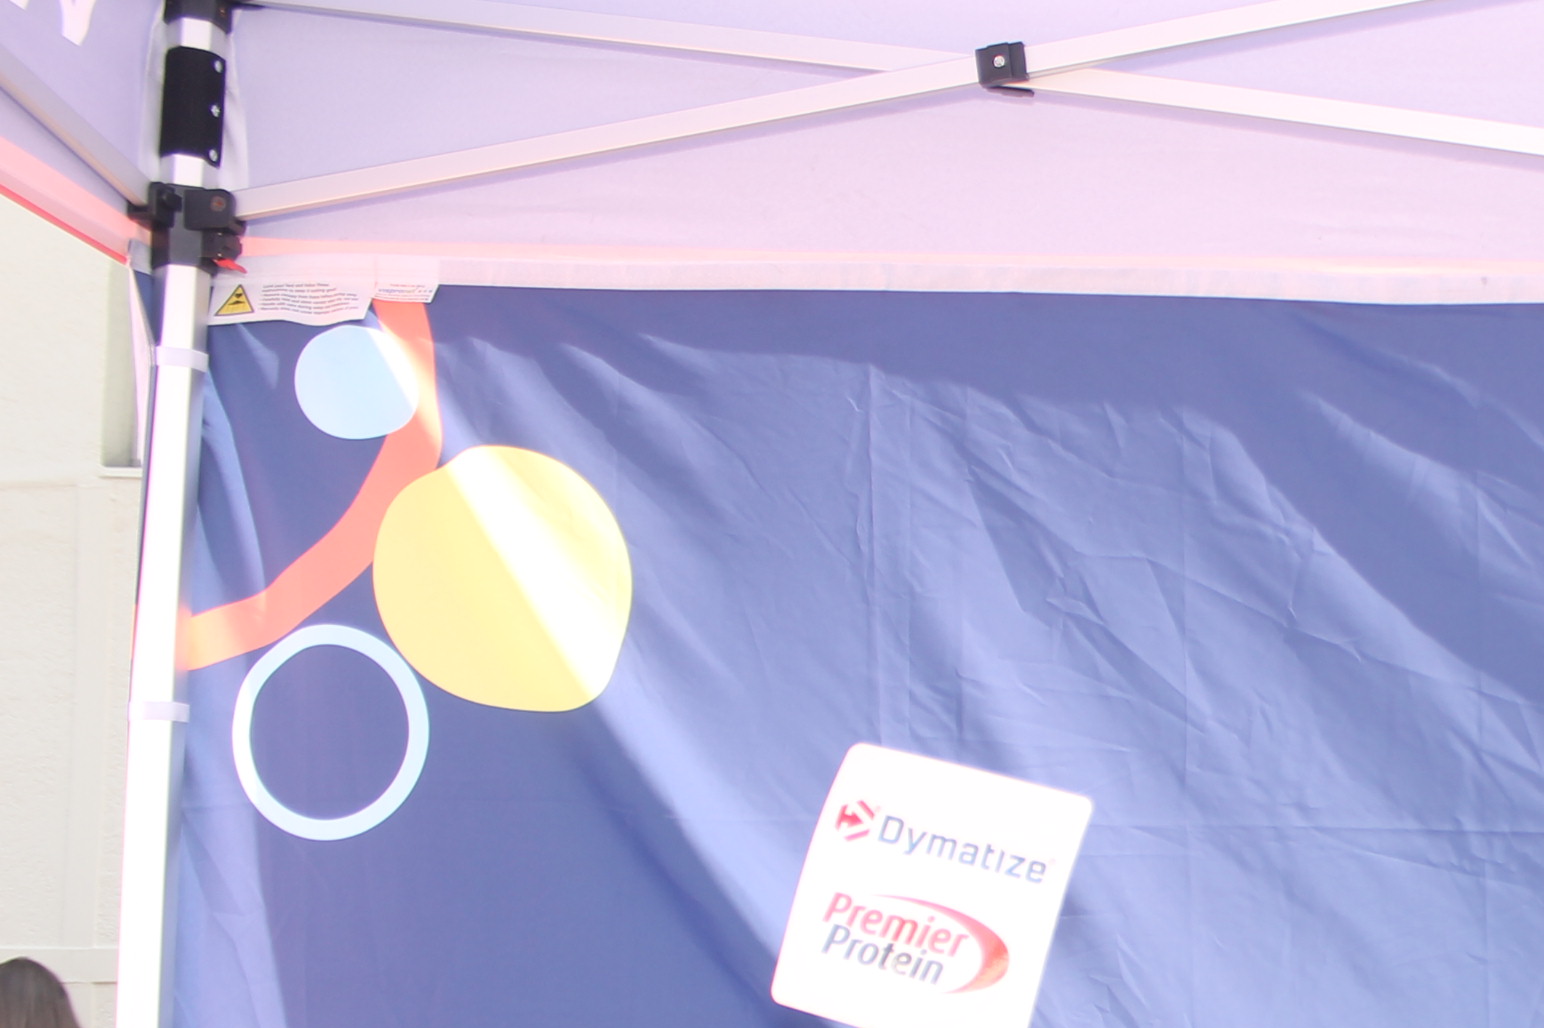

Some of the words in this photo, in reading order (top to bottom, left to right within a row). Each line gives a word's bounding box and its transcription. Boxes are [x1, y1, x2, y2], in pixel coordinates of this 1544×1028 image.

[878, 815, 1047, 883] Dymatize
[822, 924, 943, 984] Protein
[823, 892, 968, 957] Premier
